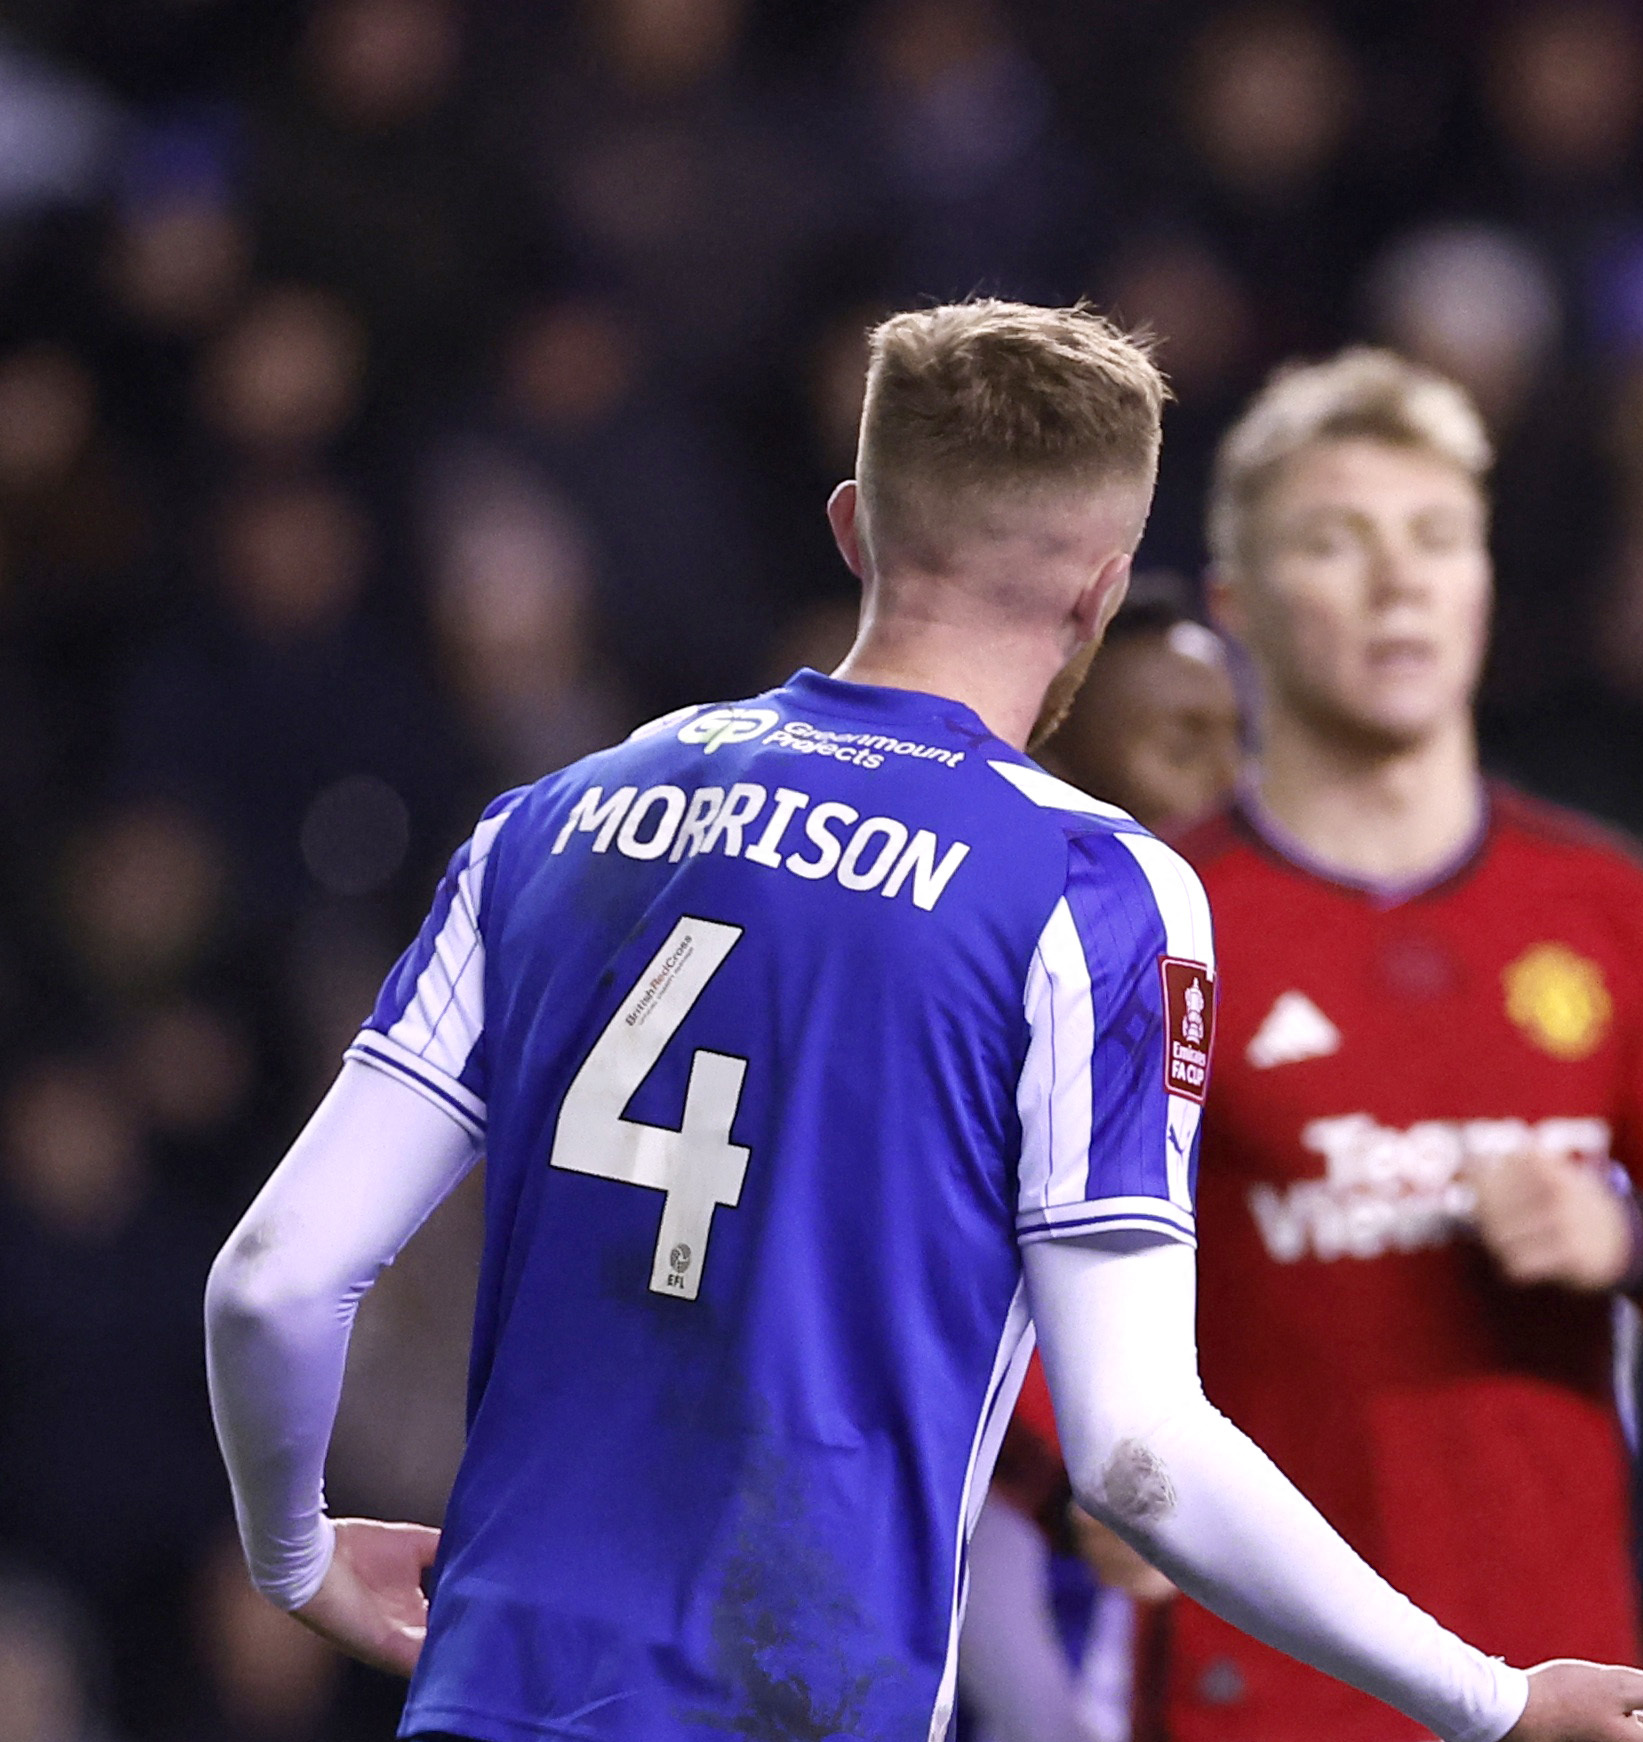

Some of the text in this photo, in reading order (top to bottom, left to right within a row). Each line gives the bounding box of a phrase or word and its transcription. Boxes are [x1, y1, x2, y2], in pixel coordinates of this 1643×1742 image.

[762, 731, 885, 769] Projects
[783, 721, 966, 768] Greenmount
[552, 783, 971, 911] MORRISON
[551, 915, 752, 1301] 4
